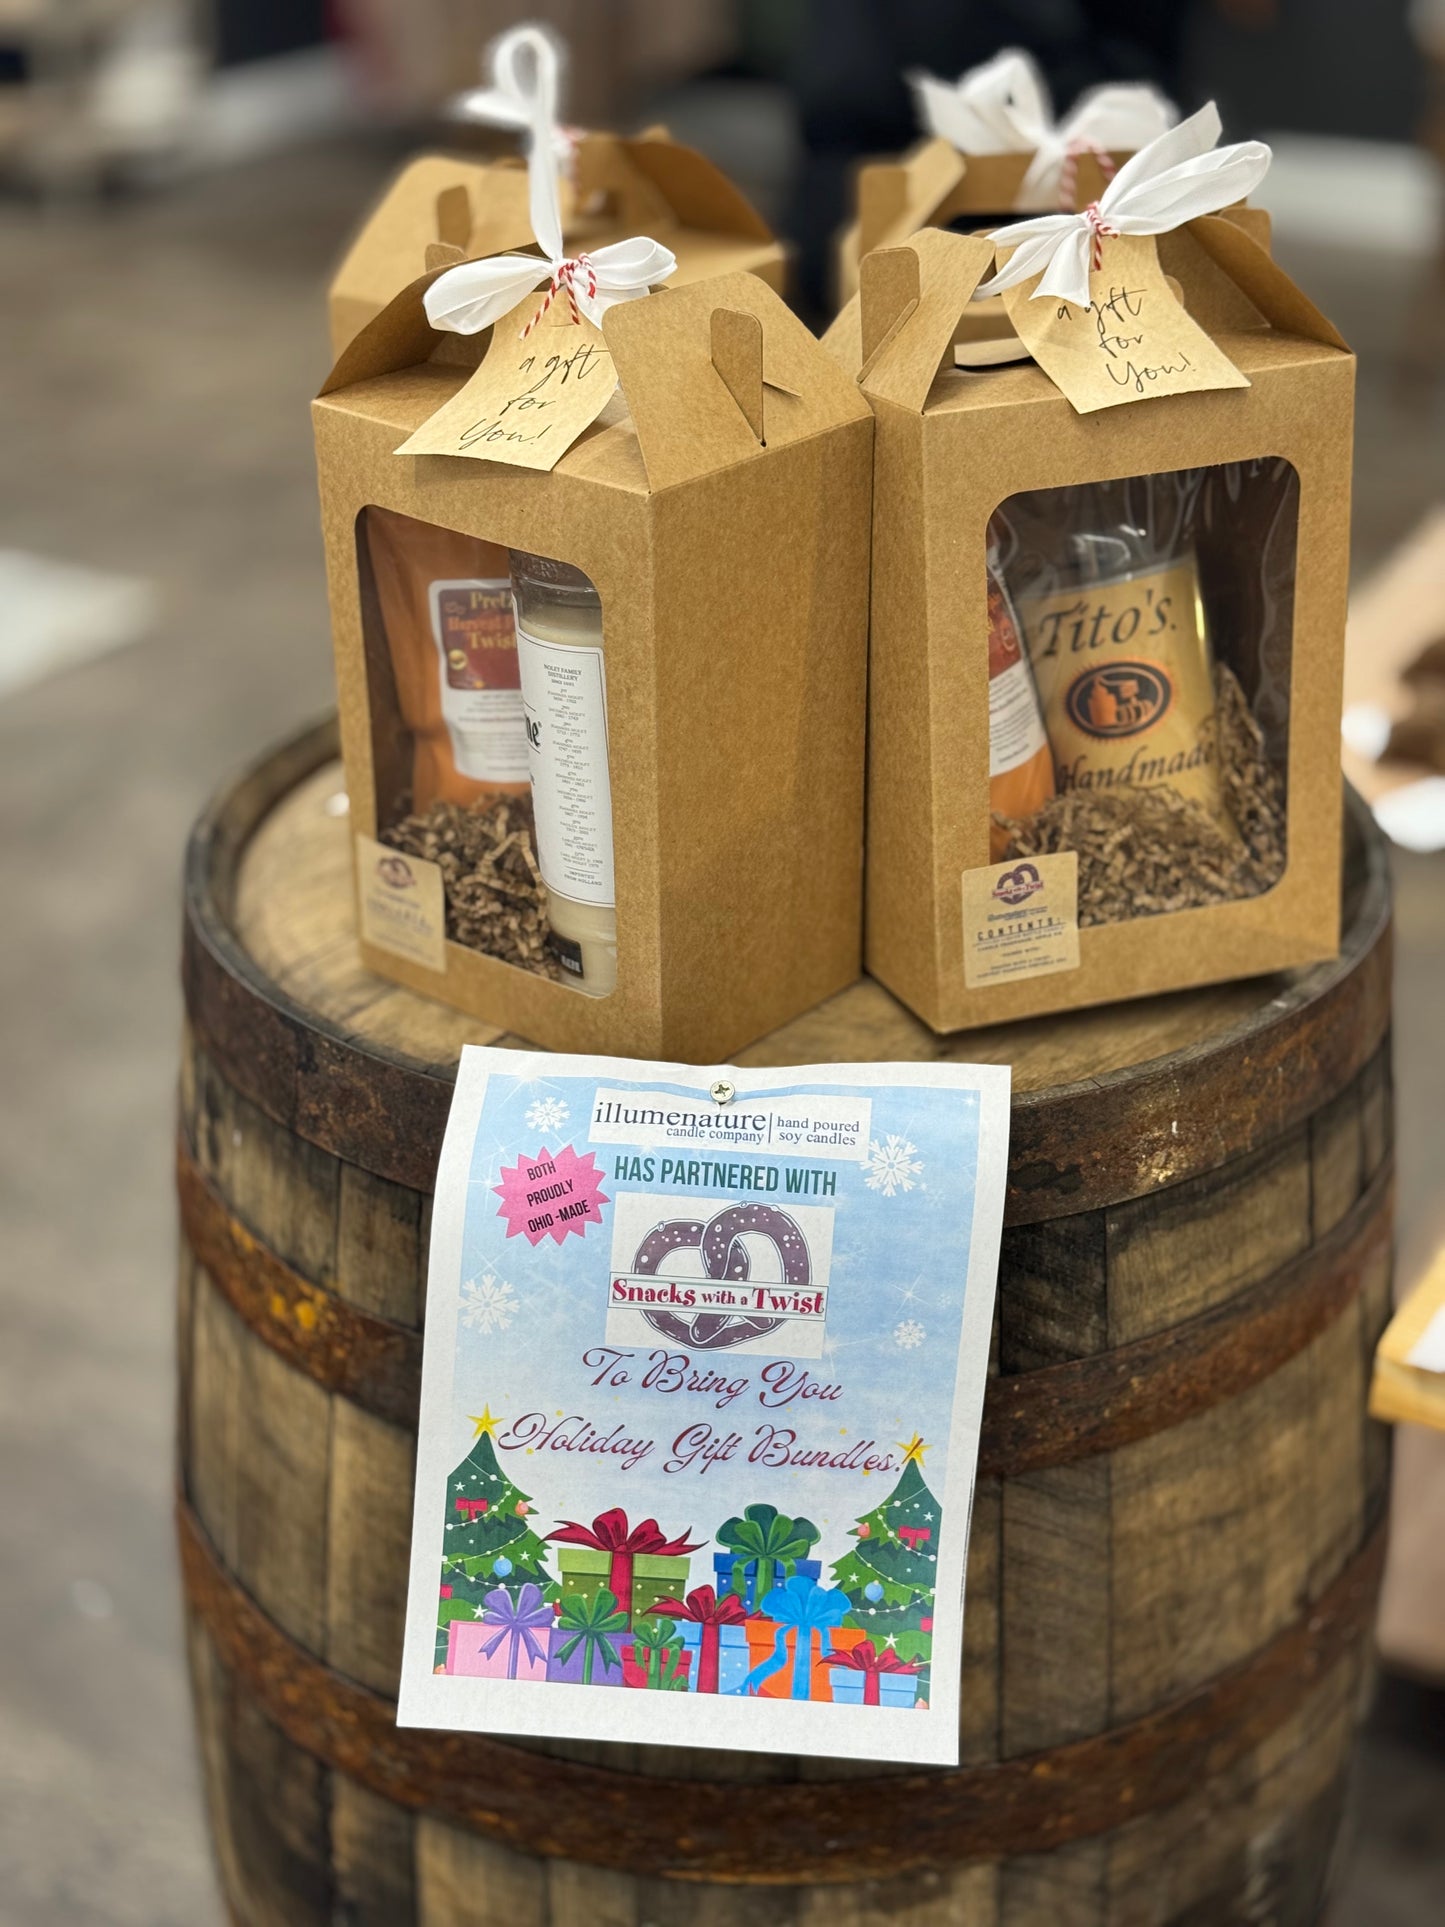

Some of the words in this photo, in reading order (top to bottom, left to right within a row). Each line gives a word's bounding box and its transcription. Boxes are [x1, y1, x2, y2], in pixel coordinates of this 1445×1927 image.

[1056, 304, 1073, 321] a
[1098, 333, 1144, 359] for
[518, 355, 536, 373] a
[528, 343, 611, 394] gift
[1106, 352, 1197, 393] You!
[499, 390, 557, 416] for
[458, 418, 553, 451] You!
[594, 1101, 767, 1131] illumenature
[776, 1116, 809, 1129] hand
[813, 1120, 860, 1132] poured
[666, 1126, 705, 1138] candle
[709, 1130, 764, 1145] company
[778, 1132, 803, 1145] soy
[806, 1132, 856, 1146] candles
[526, 1160, 557, 1181] BOTH
[614, 1155, 656, 1183] HAS
[660, 1158, 780, 1192] PARTNERED
[785, 1167, 837, 1196] WITH
[526, 1178, 574, 1207] PROUDLY
[527, 1213, 554, 1233] OHIO
[612, 1278, 696, 1307] Snacks
[701, 1290, 736, 1305] with
[740, 1295, 748, 1306] a
[752, 1287, 825, 1314] Twist
[582, 1347, 635, 1387] To
[641, 1349, 751, 1409] Bring
[759, 1360, 845, 1408] You
[497, 1412, 656, 1471] Holiday
[662, 1422, 743, 1475] Gift
[747, 1423, 925, 1473] Bundles!
